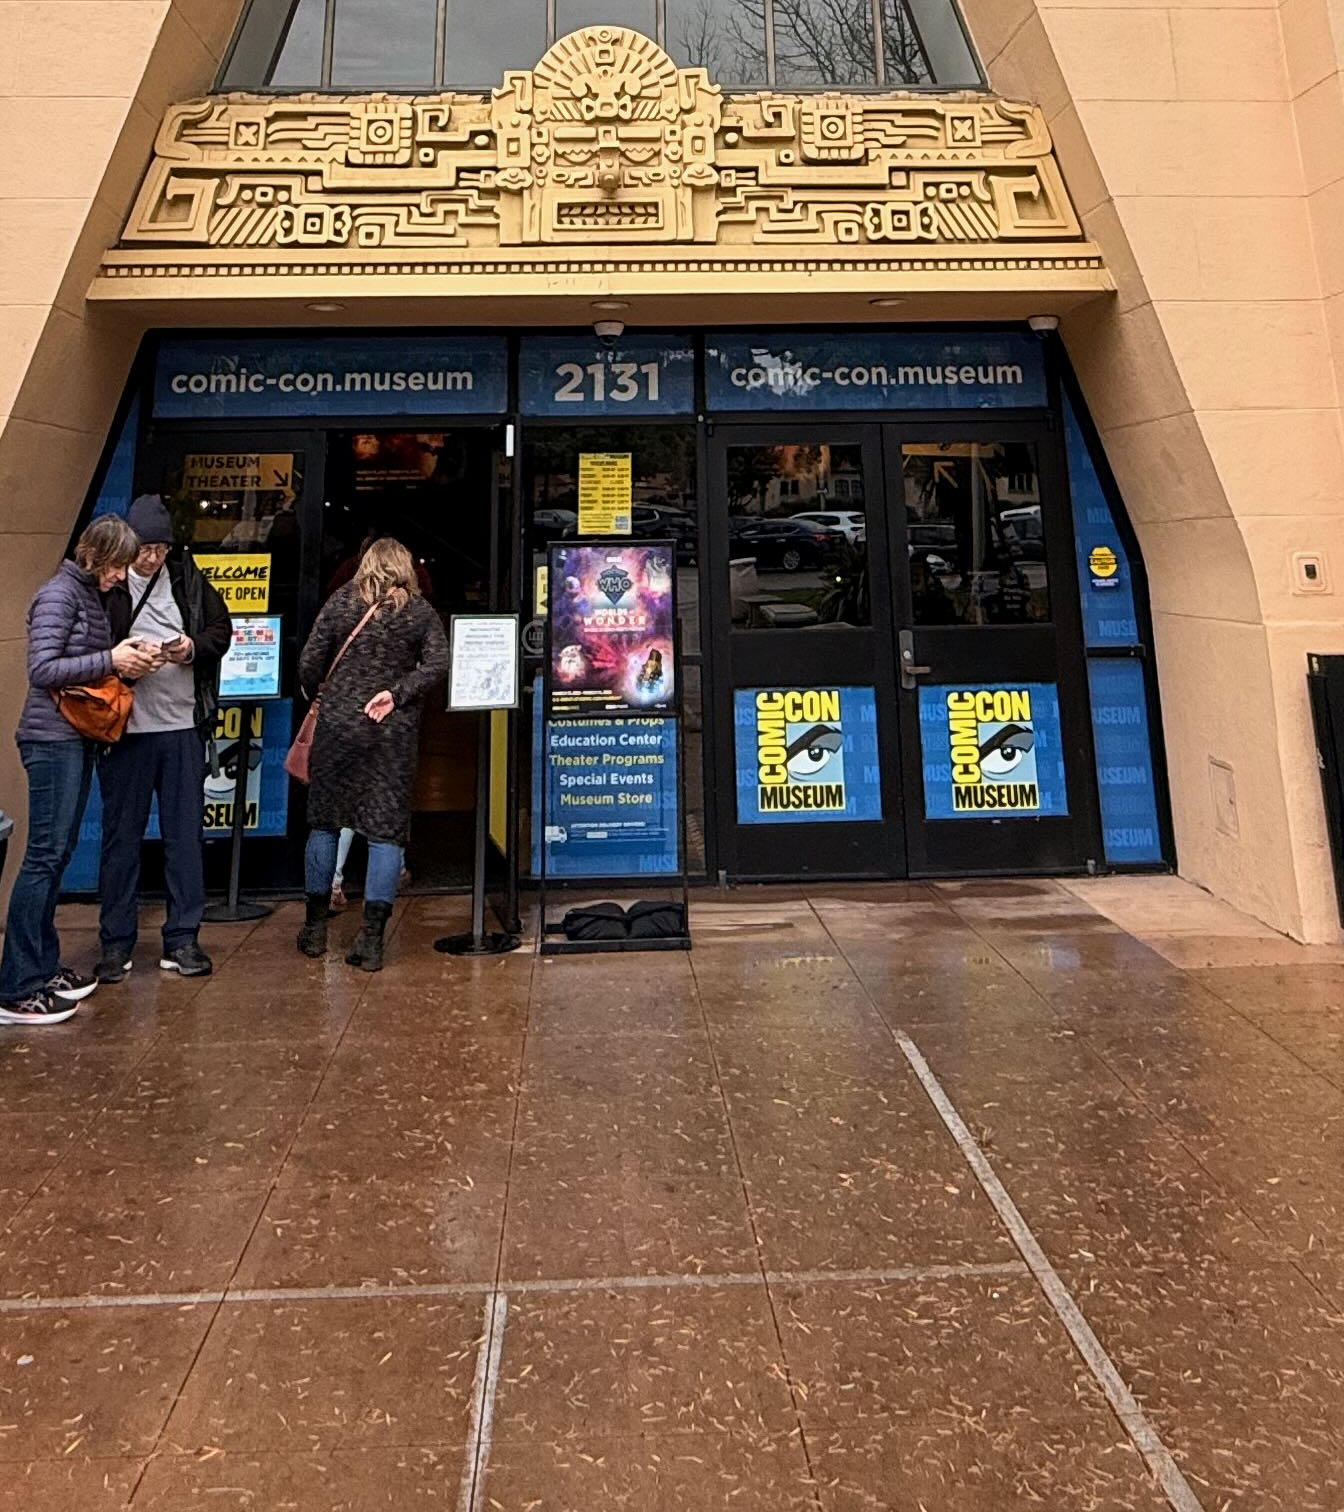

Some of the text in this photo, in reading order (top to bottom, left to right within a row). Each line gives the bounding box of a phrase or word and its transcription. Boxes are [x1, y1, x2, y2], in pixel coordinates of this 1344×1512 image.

[171, 367, 473, 393] comic-con.museum
[554, 362, 659, 402] 2131
[730, 362, 1023, 387] comic-con.museum
[190, 456, 260, 470] MUSEUM
[188, 474, 261, 488] THEATER
[236, 586, 266, 600] OPEN
[599, 577, 632, 592] WHO
[584, 616, 646, 626] WONDER
[784, 690, 840, 722] CON
[976, 690, 1031, 722] CON
[550, 734, 663, 747] Education Center
[756, 692, 788, 784] COMIC
[947, 691, 981, 783] COMIC
[549, 753, 665, 767] Theater Programs
[560, 773, 654, 788] Special Events
[560, 793, 614, 806] Museum
[617, 792, 653, 805] Store
[760, 784, 843, 810] MUSEUM
[955, 783, 1038, 809] MUSEUM
